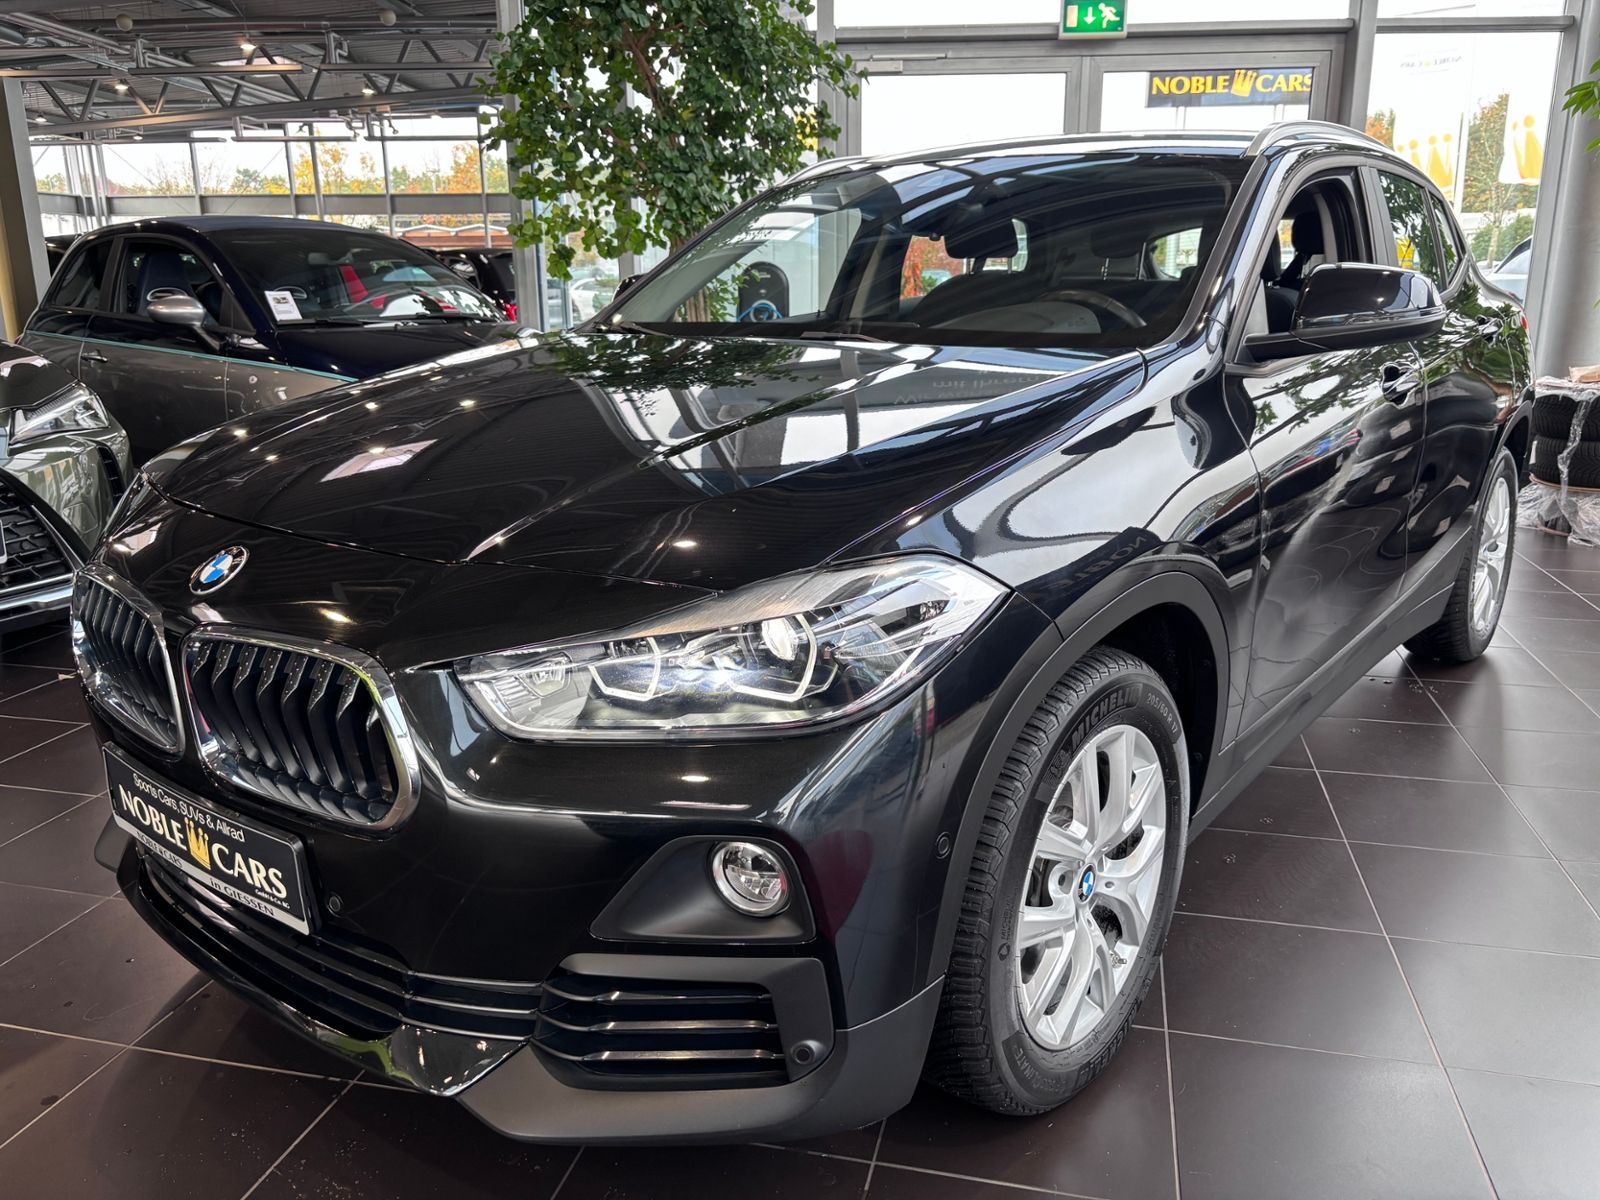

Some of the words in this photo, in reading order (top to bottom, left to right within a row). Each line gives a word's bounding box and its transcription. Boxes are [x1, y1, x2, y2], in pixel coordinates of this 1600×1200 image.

[1152, 75, 1230, 95] NOBLE
[1072, 687, 1140, 752] MICHELIN
[133, 773, 158, 798] Sports
[158, 789, 180, 813] Cars,
[179, 801, 205, 824] SUVs
[206, 815, 215, 830] &
[217, 819, 246, 843] Allrad
[119, 784, 187, 851] NOBLE
[211, 843, 287, 899] CARS
[209, 878, 221, 890] in
[224, 885, 275, 916] GIESSEN
